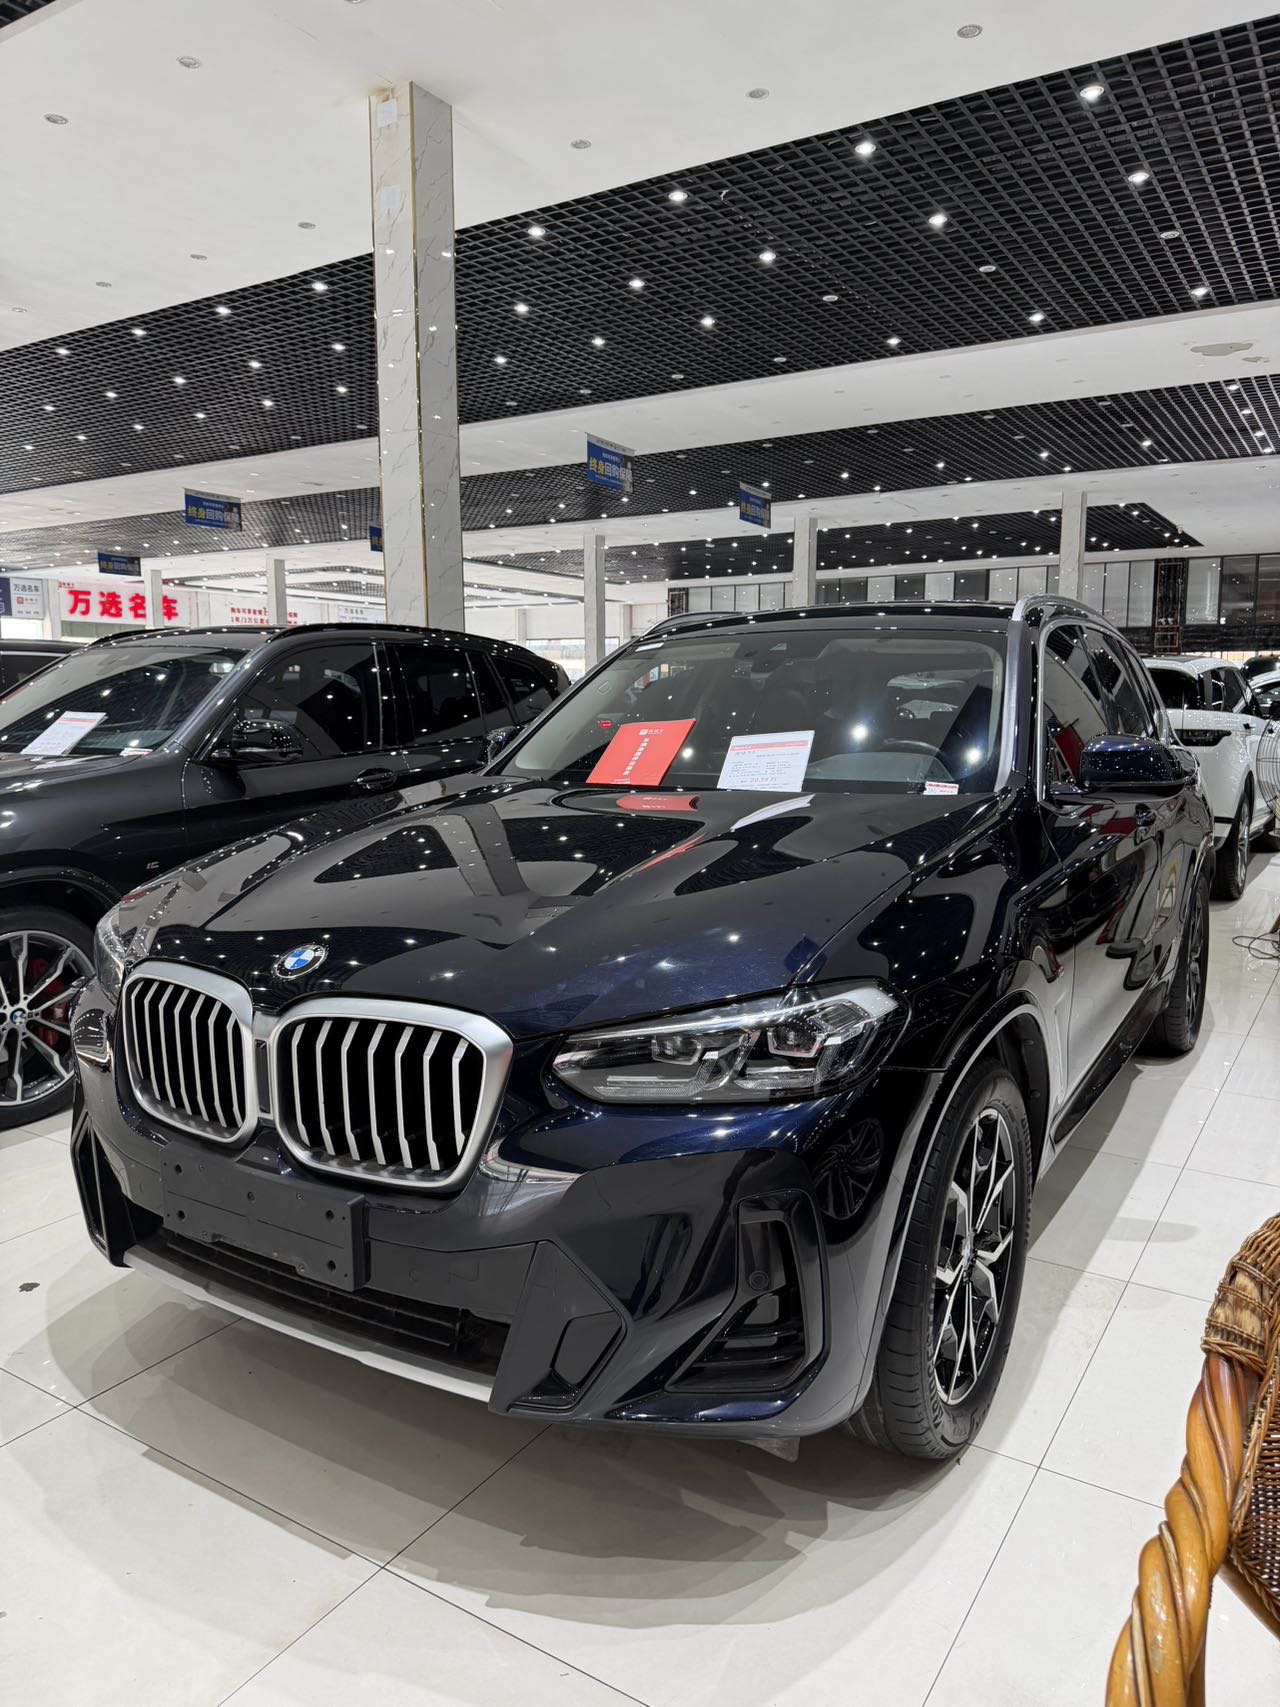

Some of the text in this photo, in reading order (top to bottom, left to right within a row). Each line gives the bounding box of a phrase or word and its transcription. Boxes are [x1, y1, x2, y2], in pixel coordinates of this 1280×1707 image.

[13, 583, 41, 593] 万选名车
[68, 589, 179, 621] 万选名车
